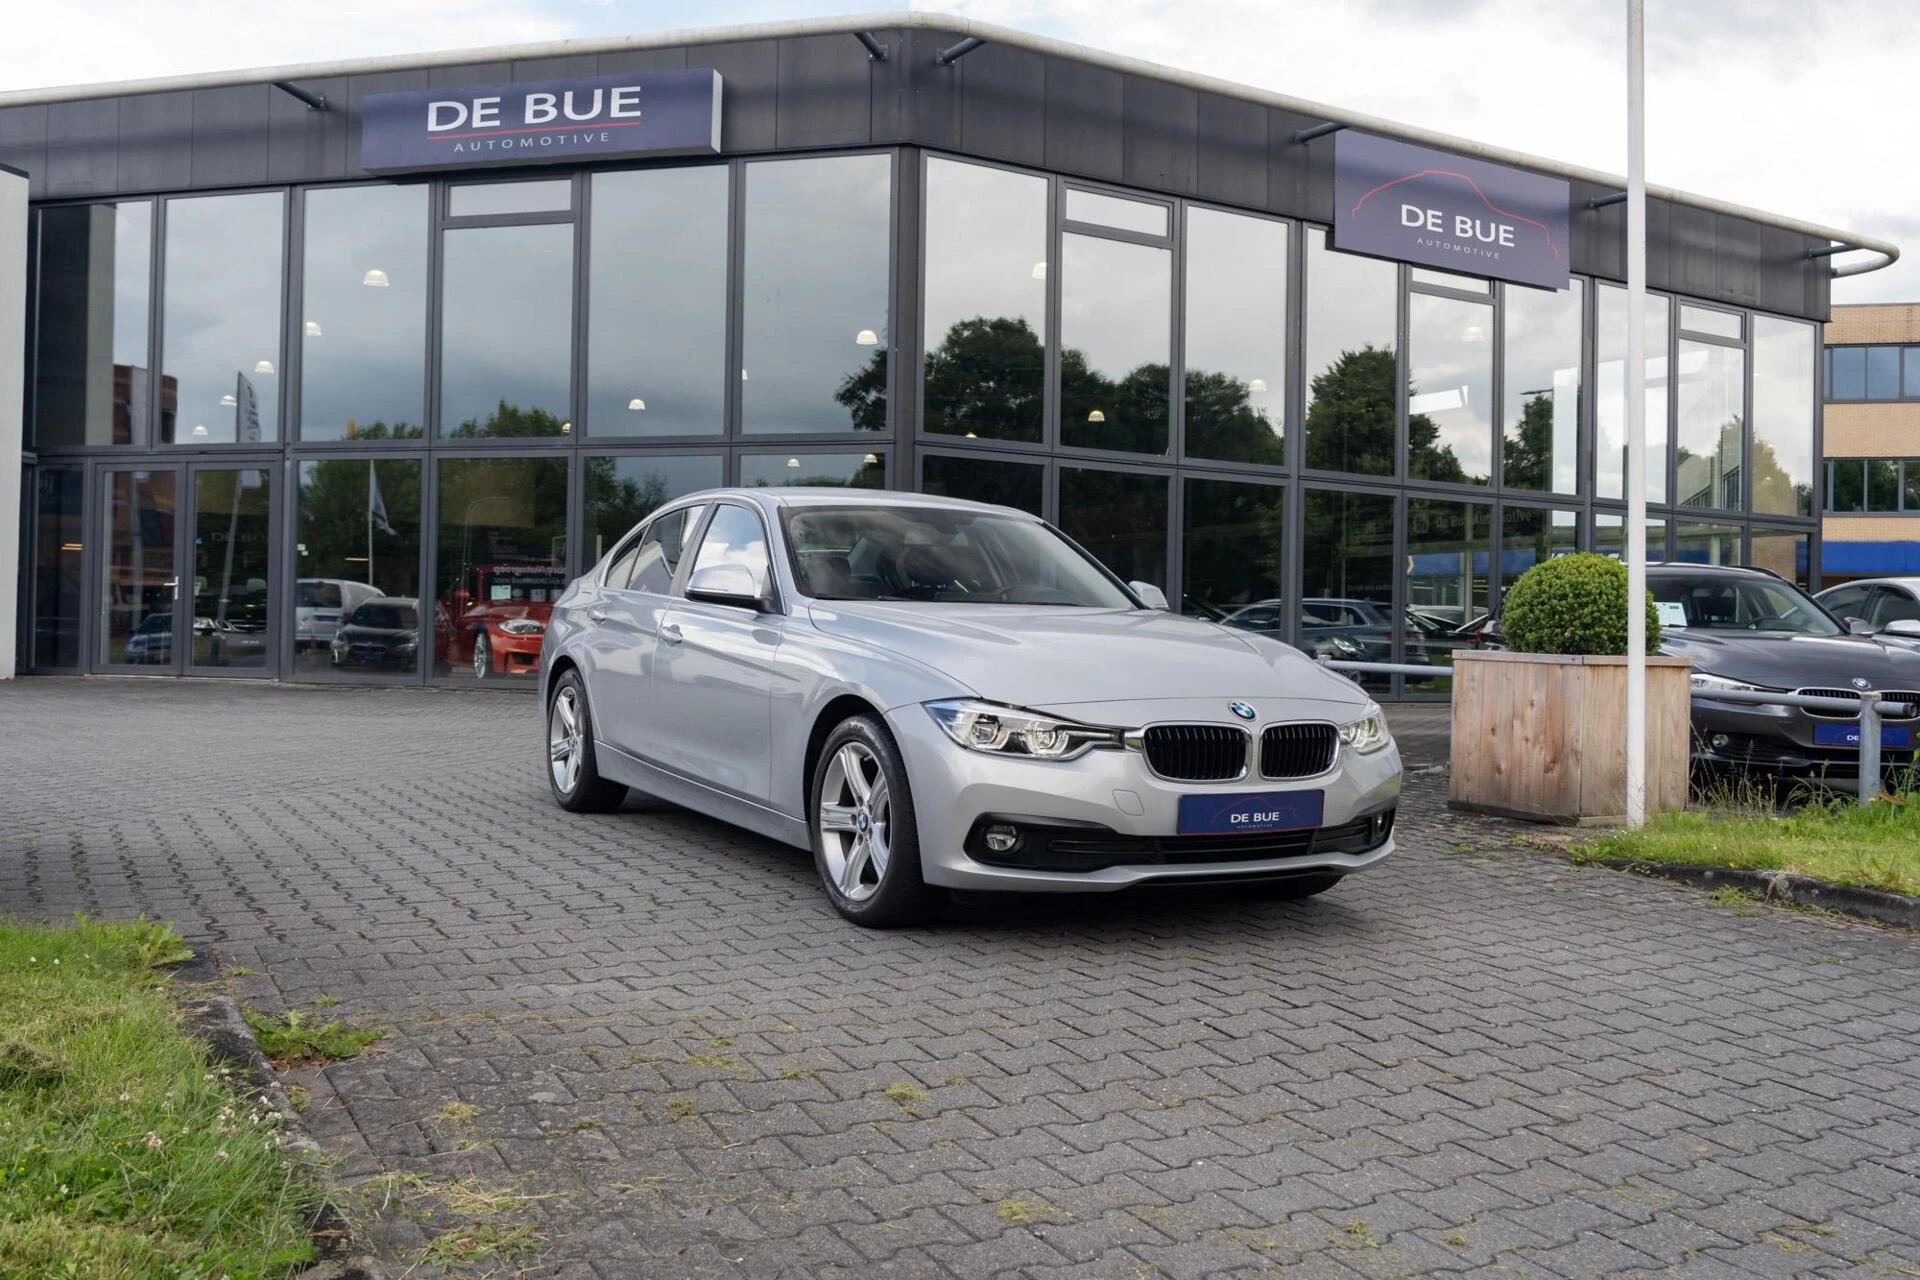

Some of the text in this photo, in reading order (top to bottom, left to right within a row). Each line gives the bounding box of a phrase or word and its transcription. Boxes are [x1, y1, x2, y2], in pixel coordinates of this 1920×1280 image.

[427, 86, 641, 132] DE BUE
[454, 132, 610, 152] AUTOMOTIVE
[1401, 204, 1515, 247] DE BUE
[1417, 237, 1500, 259] AUTOMOTIVE
[1231, 811, 1279, 823] DE BUE
